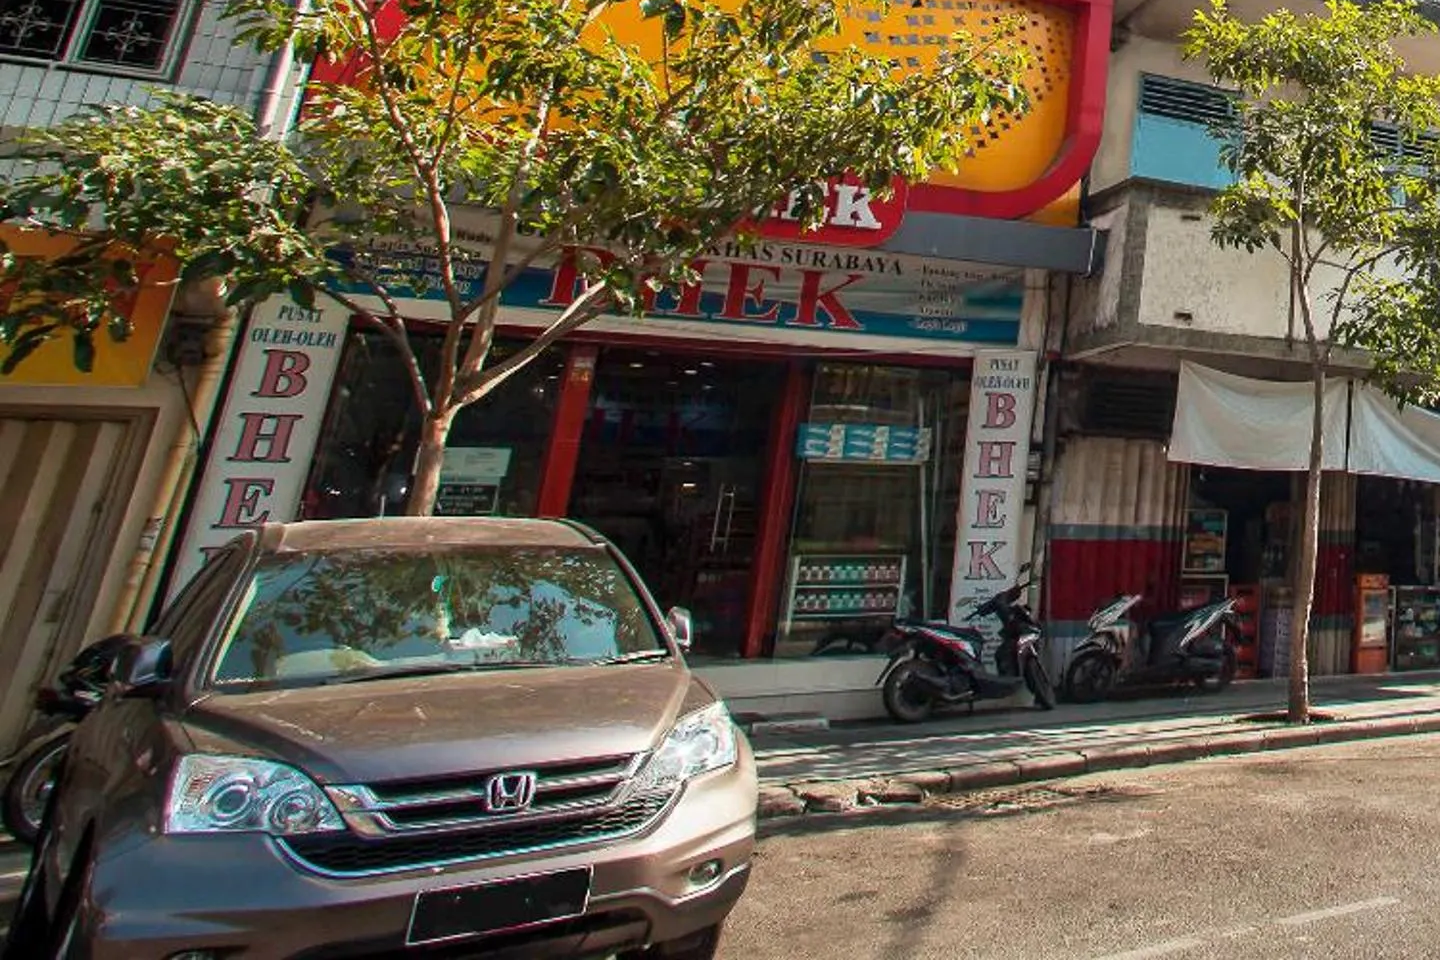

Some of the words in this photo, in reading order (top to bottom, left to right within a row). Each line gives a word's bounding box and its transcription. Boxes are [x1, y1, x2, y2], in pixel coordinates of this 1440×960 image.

[779, 248, 904, 276] SURABAYA
[277, 304, 325, 323] PUSAT
[251, 326, 338, 347] OLEH-OLEH
[197, 348, 311, 562] BHE
[964, 392, 1017, 580] BHEK
